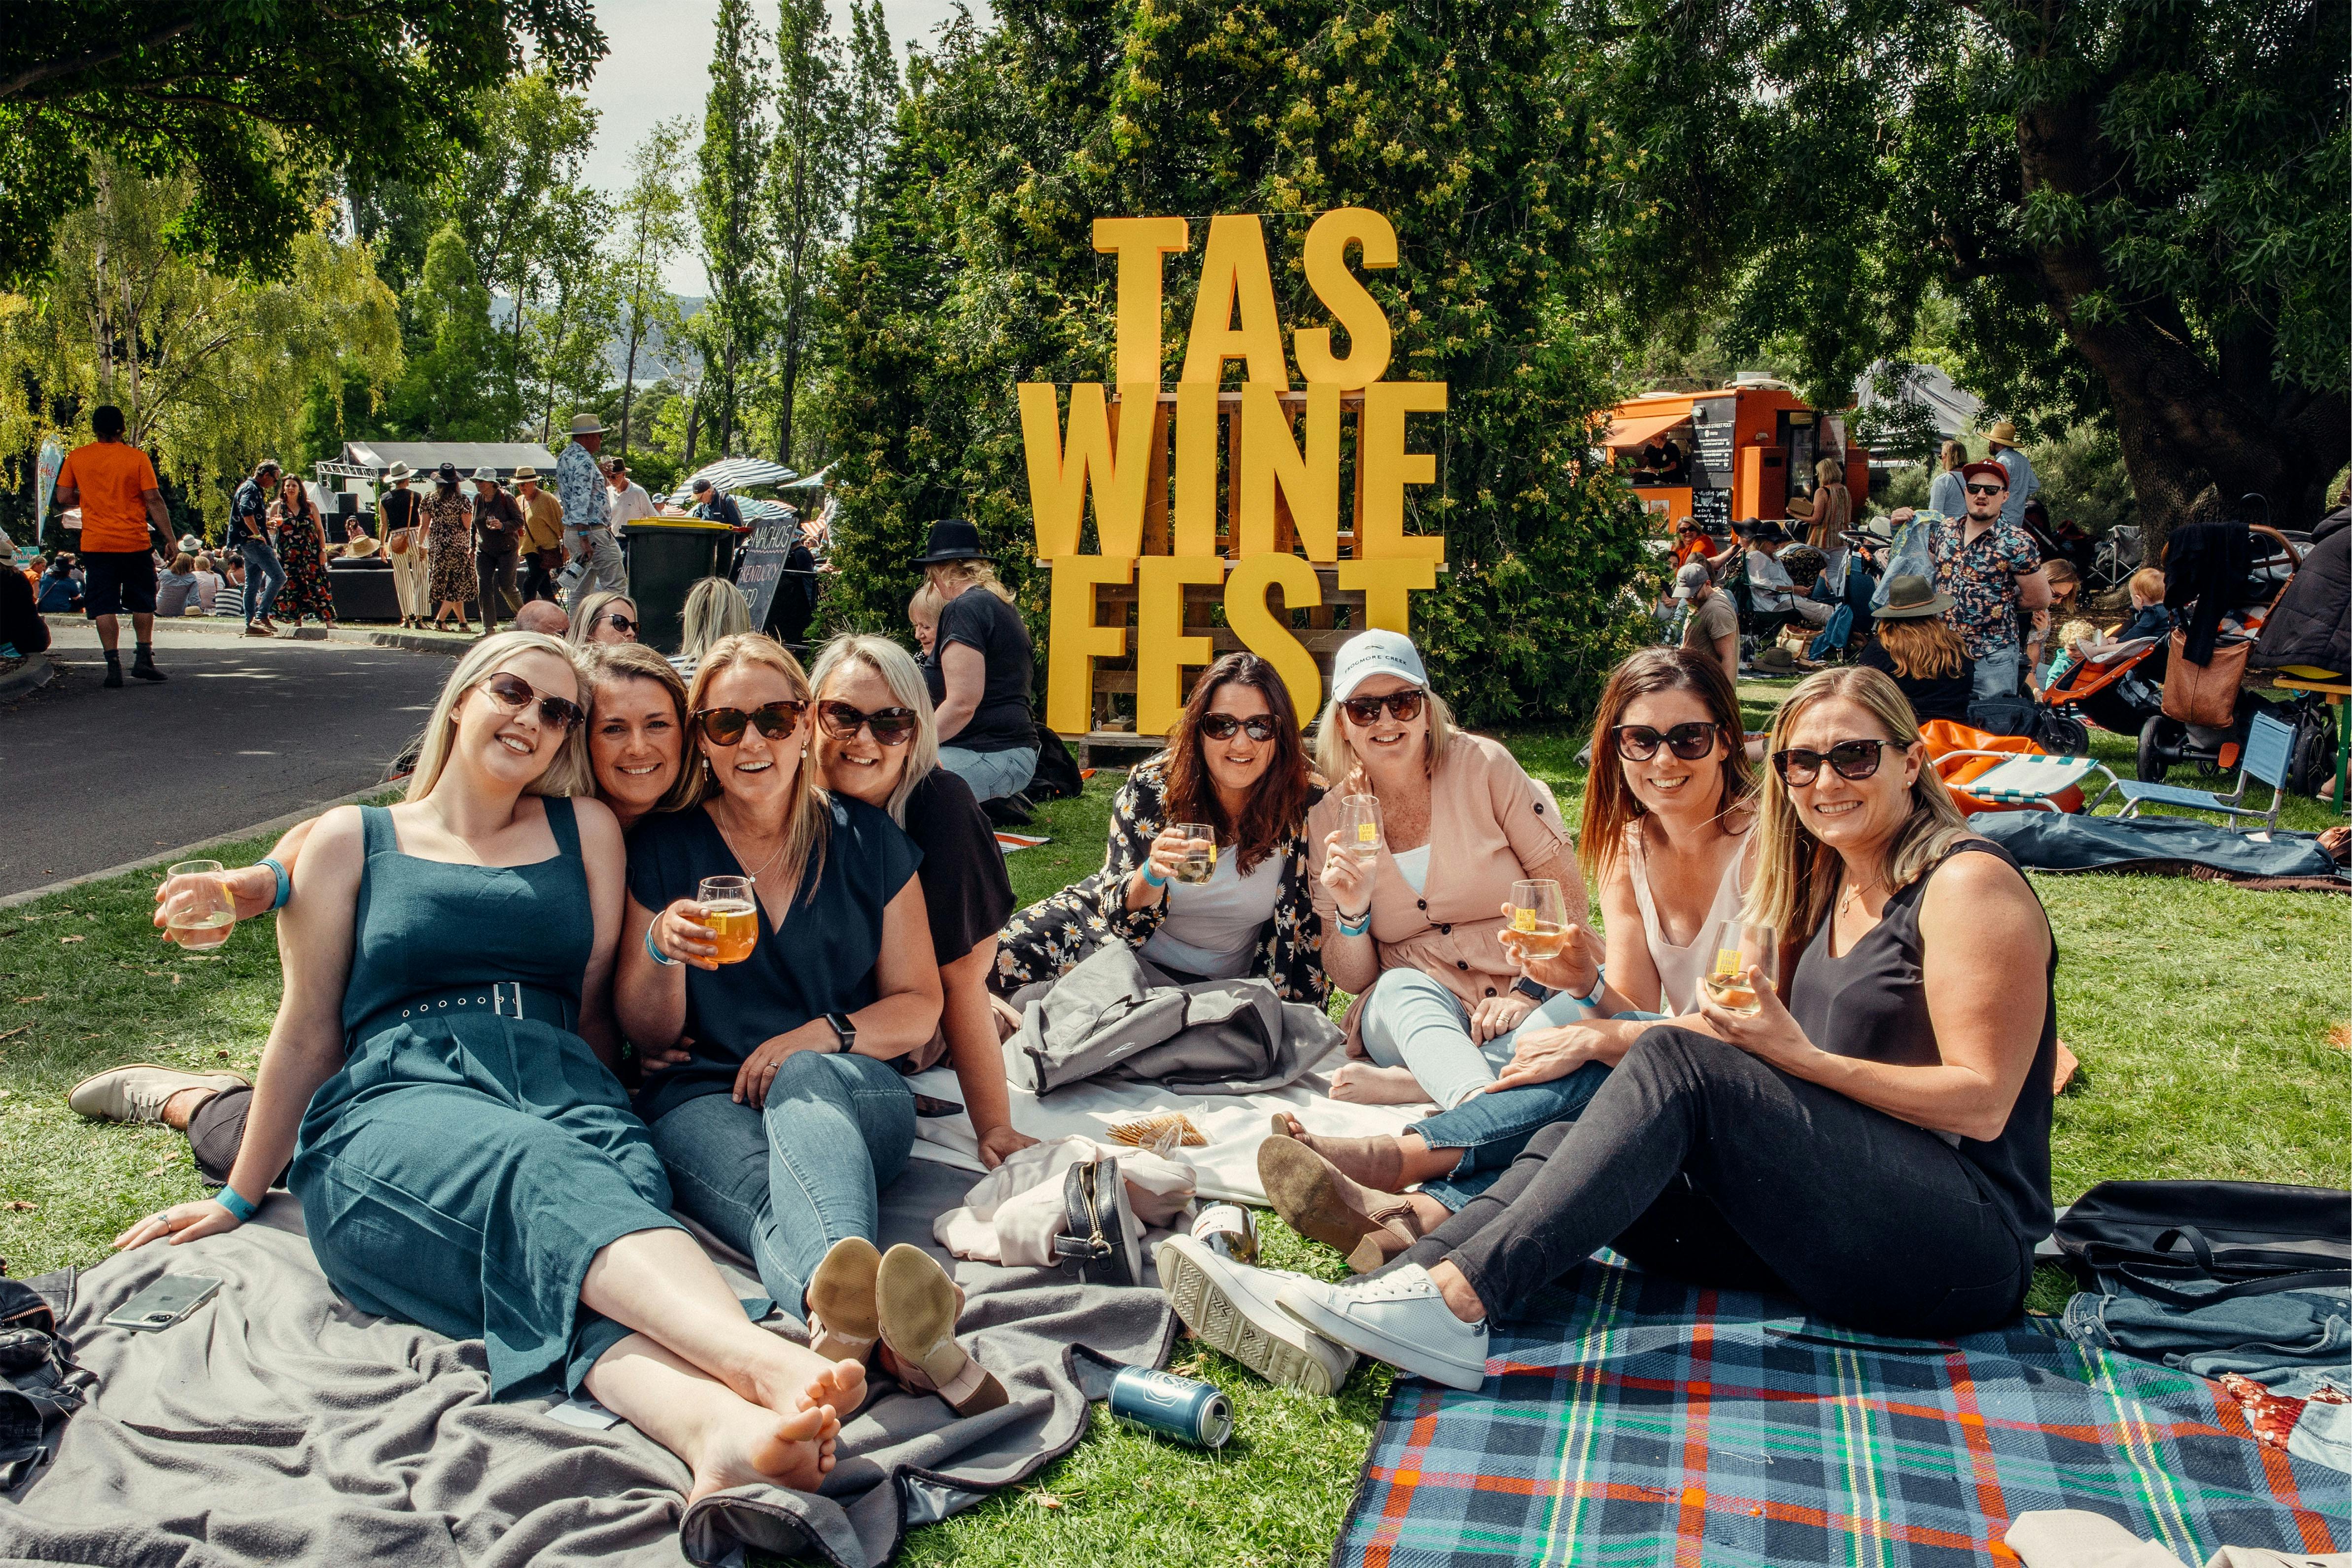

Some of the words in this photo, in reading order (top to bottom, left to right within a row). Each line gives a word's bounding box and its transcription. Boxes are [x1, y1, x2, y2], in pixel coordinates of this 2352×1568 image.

[1093, 207, 1398, 393] TAS
[1017, 382, 1447, 563] WINE
[741, 563, 780, 583] KENTUCKY
[751, 525, 792, 550] NACHOS
[1046, 552, 1436, 735] FEST
[1345, 655, 1382, 674] FROGMORE
[1385, 655, 1407, 666] CREEK
